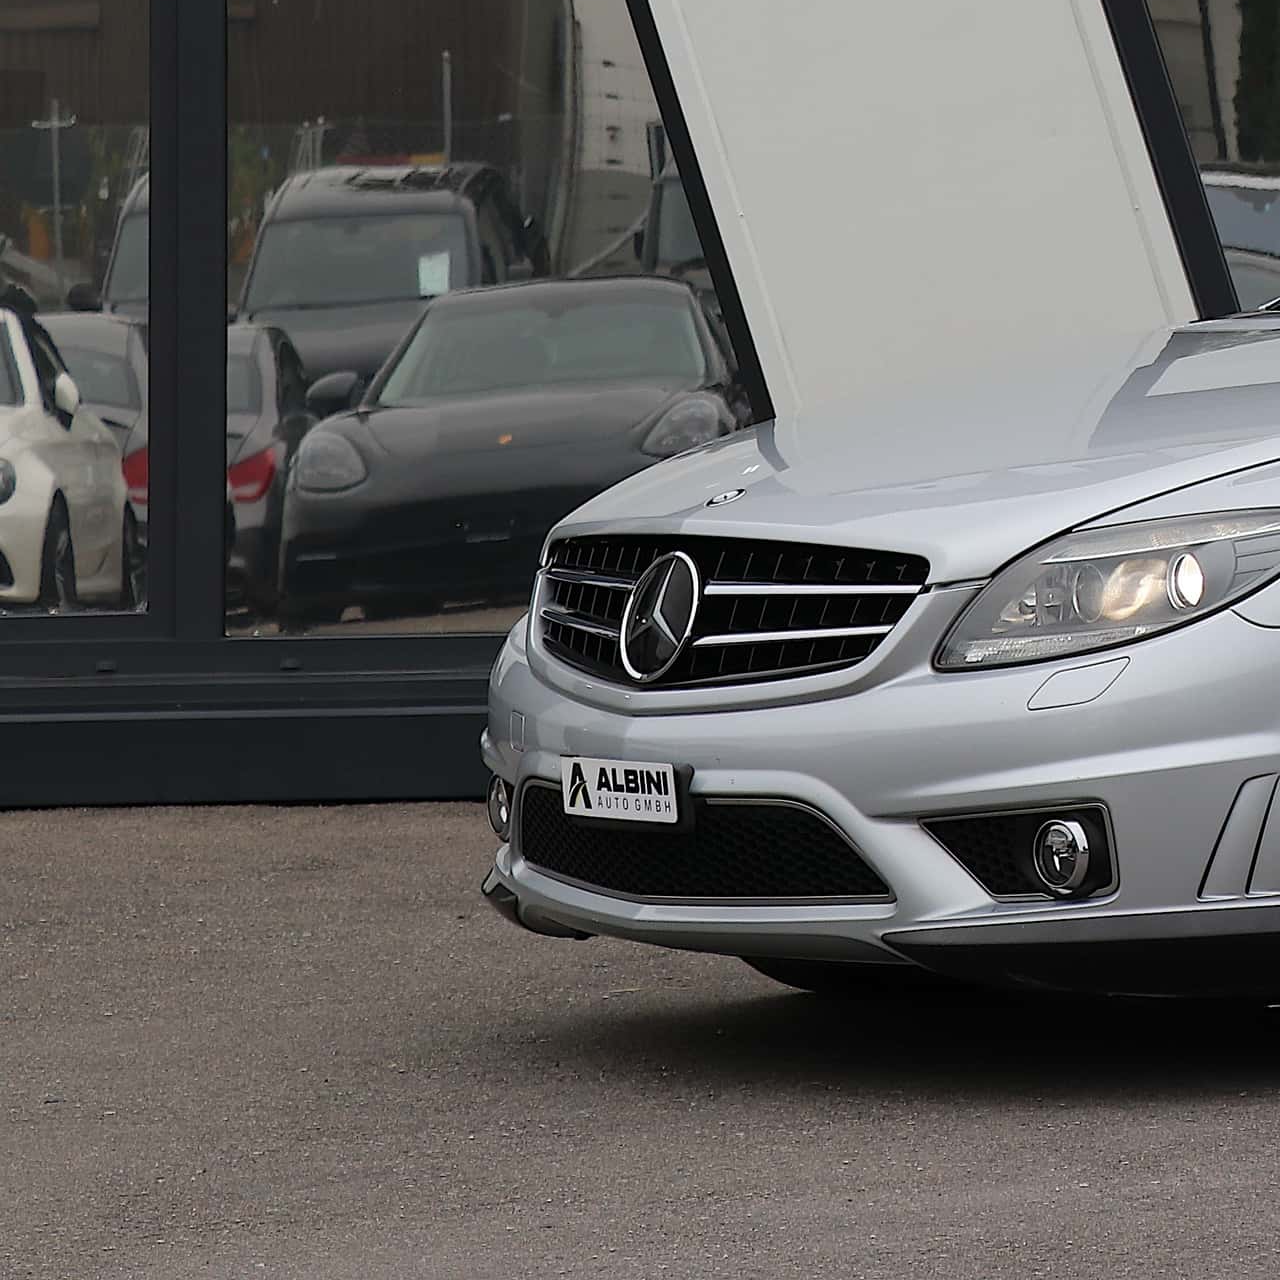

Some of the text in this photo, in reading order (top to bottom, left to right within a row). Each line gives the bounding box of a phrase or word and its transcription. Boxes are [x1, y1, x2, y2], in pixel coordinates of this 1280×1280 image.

[597, 767, 669, 795] ALBINI
[597, 796, 671, 813] AUTO GMBH
